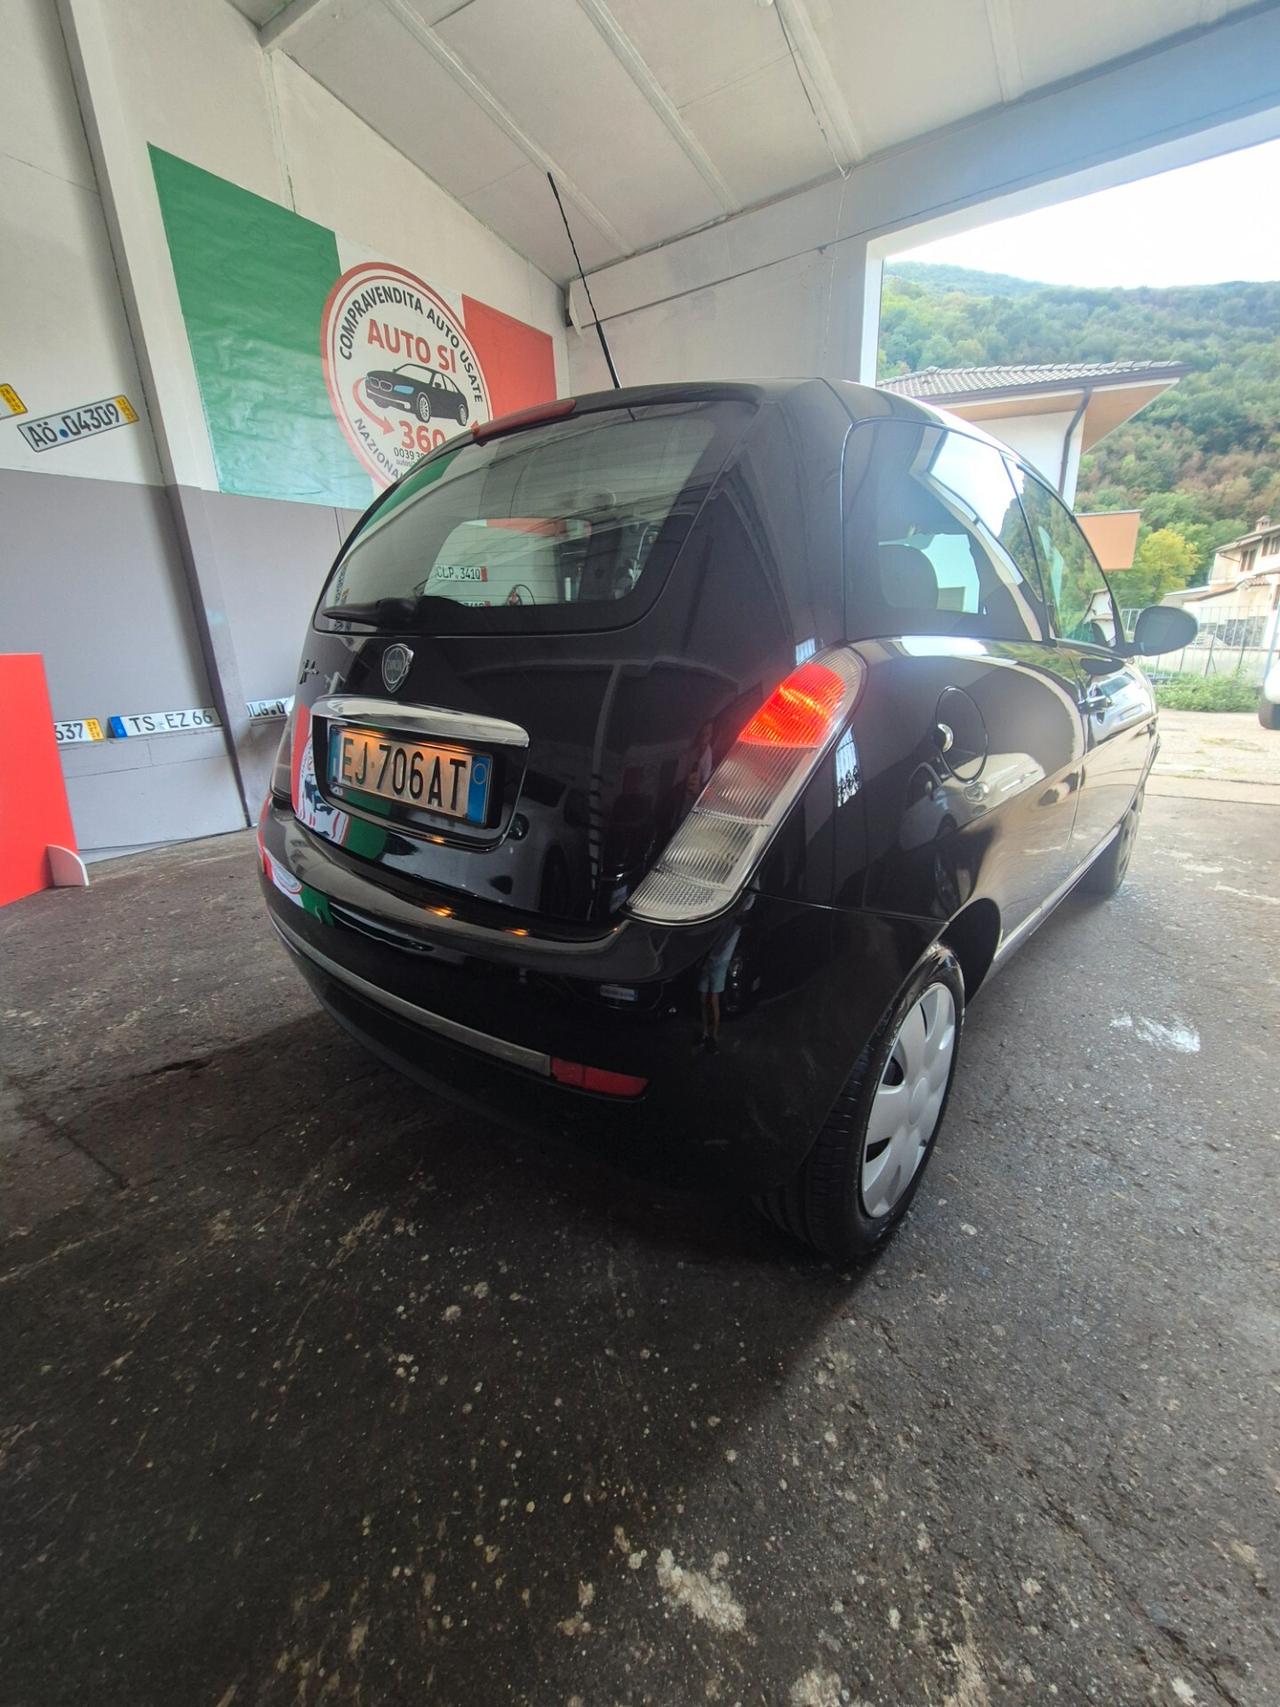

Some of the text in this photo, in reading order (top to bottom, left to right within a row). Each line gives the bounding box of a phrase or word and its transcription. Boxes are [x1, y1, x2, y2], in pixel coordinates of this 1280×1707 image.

[339, 286, 483, 403] COMPRAVENDITA AUTO USATE
[367, 318, 456, 374] AUTO SI
[355, 418, 404, 479] NAZIONA
[128, 715, 156, 733] TS
[192, 709, 214, 726] 66
